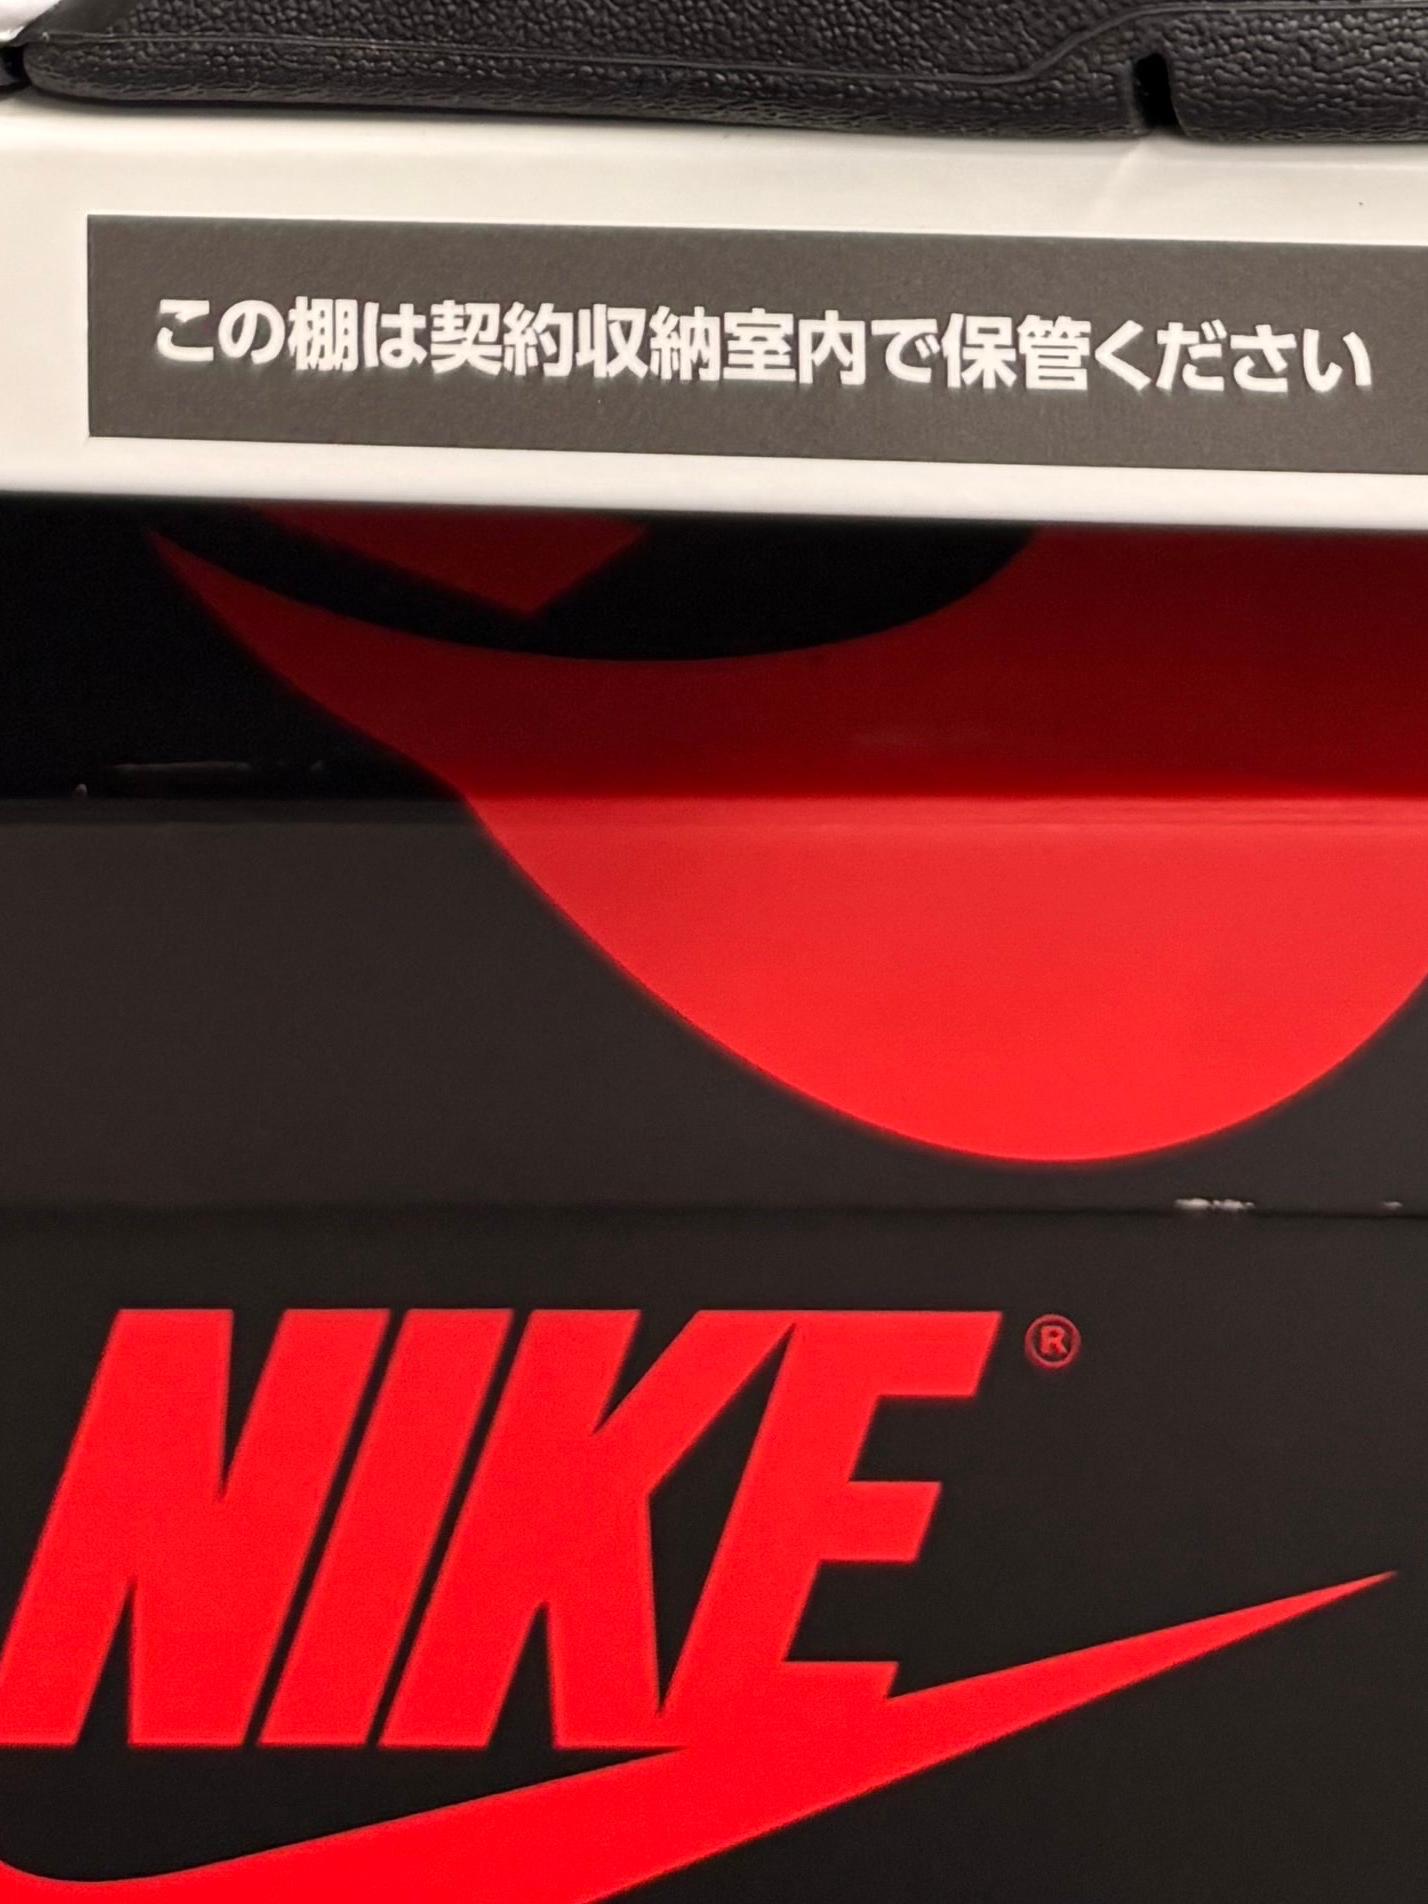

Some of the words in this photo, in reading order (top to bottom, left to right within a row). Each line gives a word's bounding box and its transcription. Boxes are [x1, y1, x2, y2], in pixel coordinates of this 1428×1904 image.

[155, 295, 1373, 394] この棚は契約収納室内で保管ください
